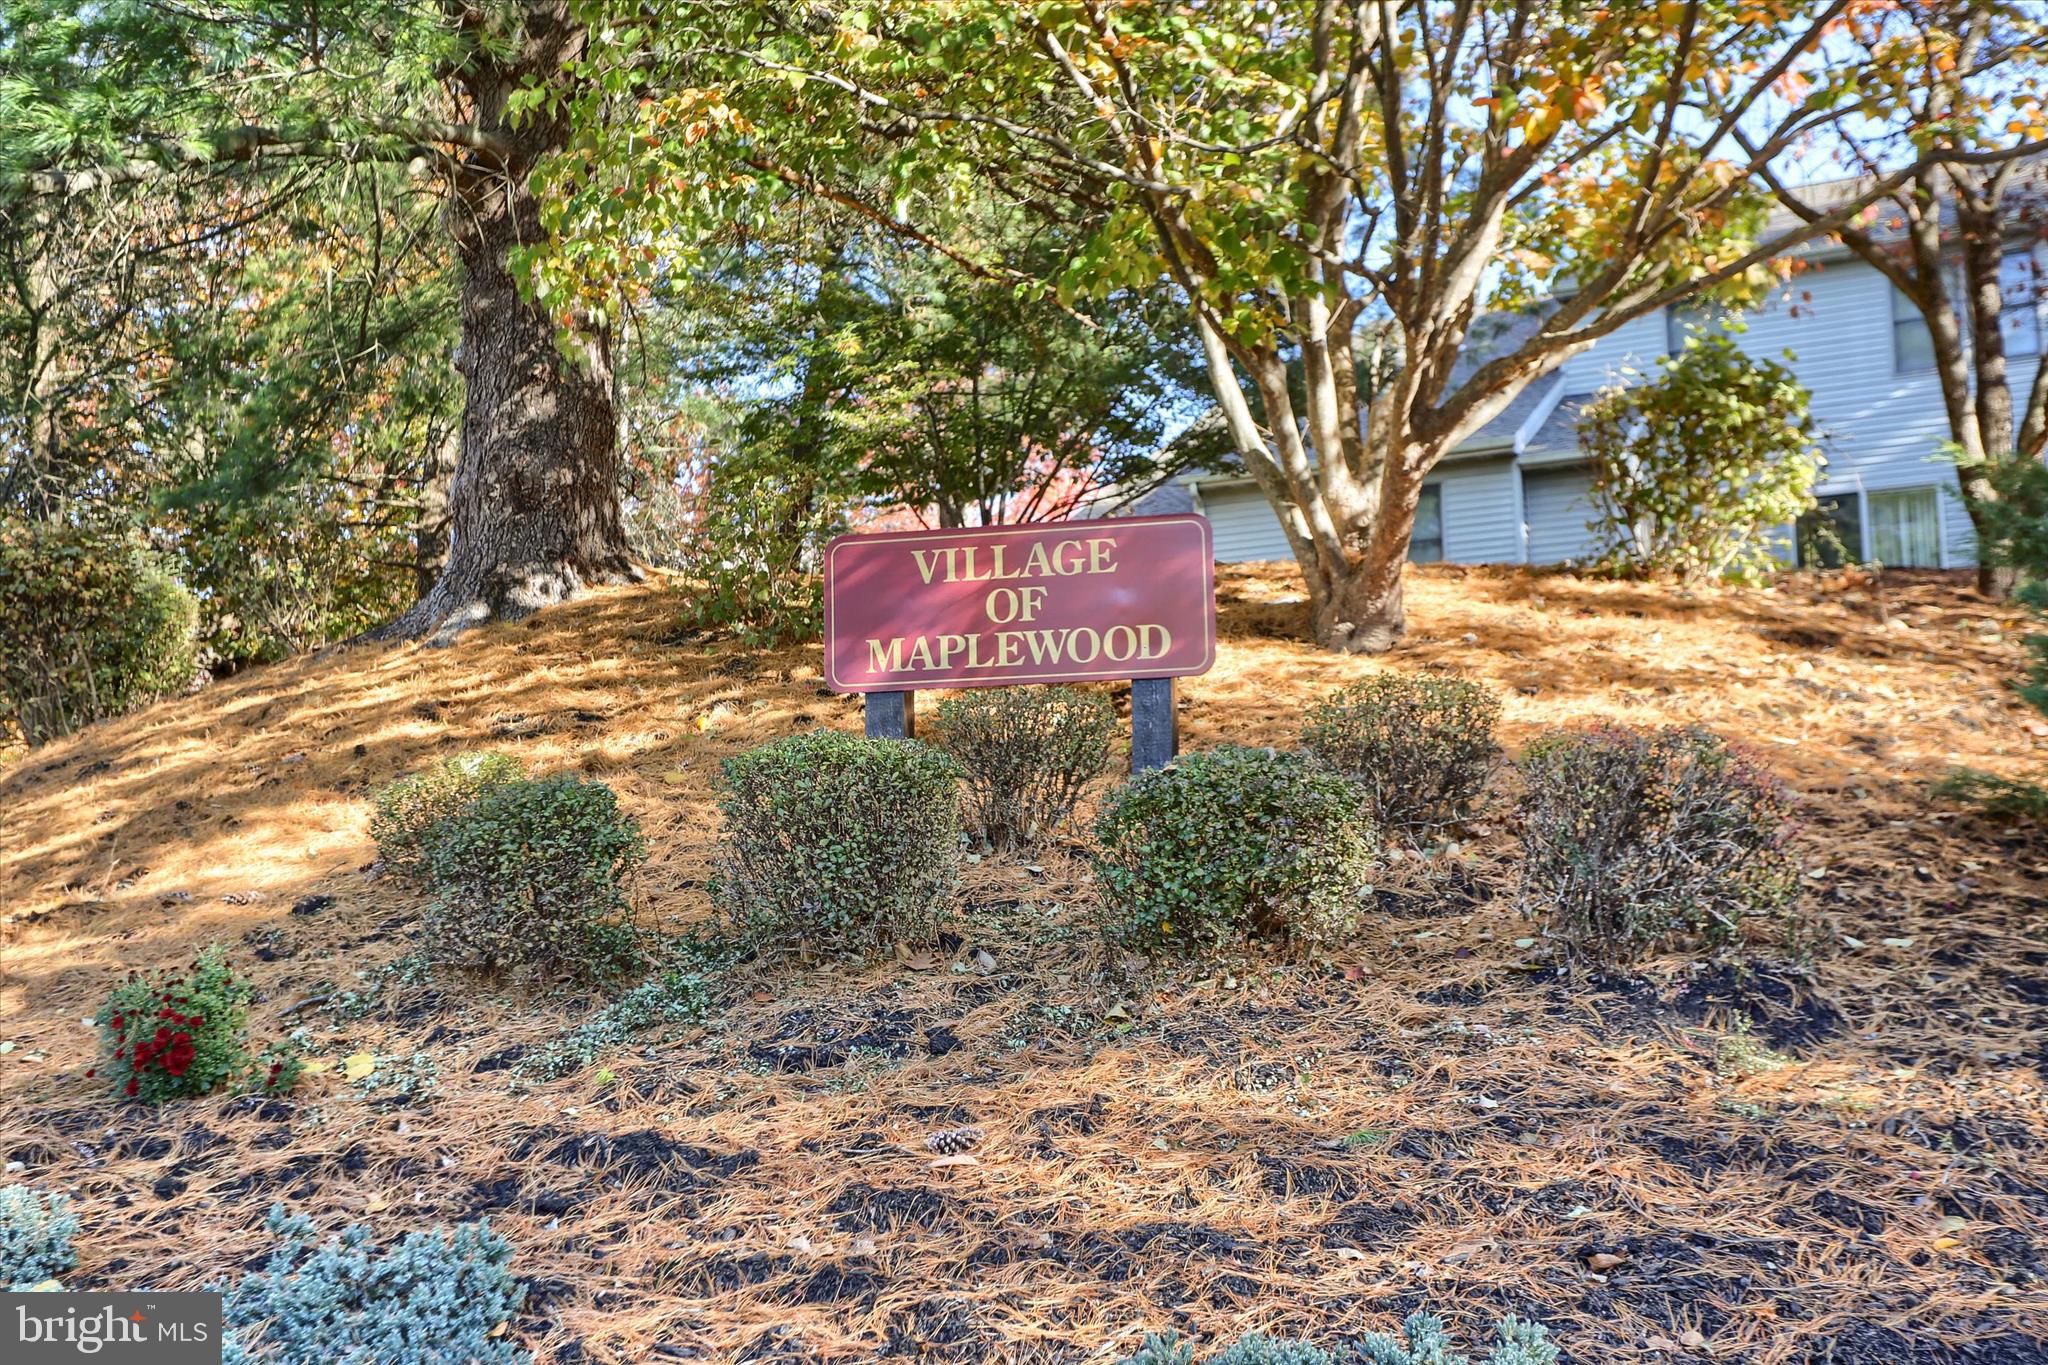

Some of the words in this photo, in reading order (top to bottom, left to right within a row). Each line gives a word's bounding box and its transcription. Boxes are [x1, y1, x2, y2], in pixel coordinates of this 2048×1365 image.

[911, 538, 1118, 584] VILLAGE
[985, 586, 1048, 624] OF
[865, 624, 1173, 674] MAPLEWOOD
